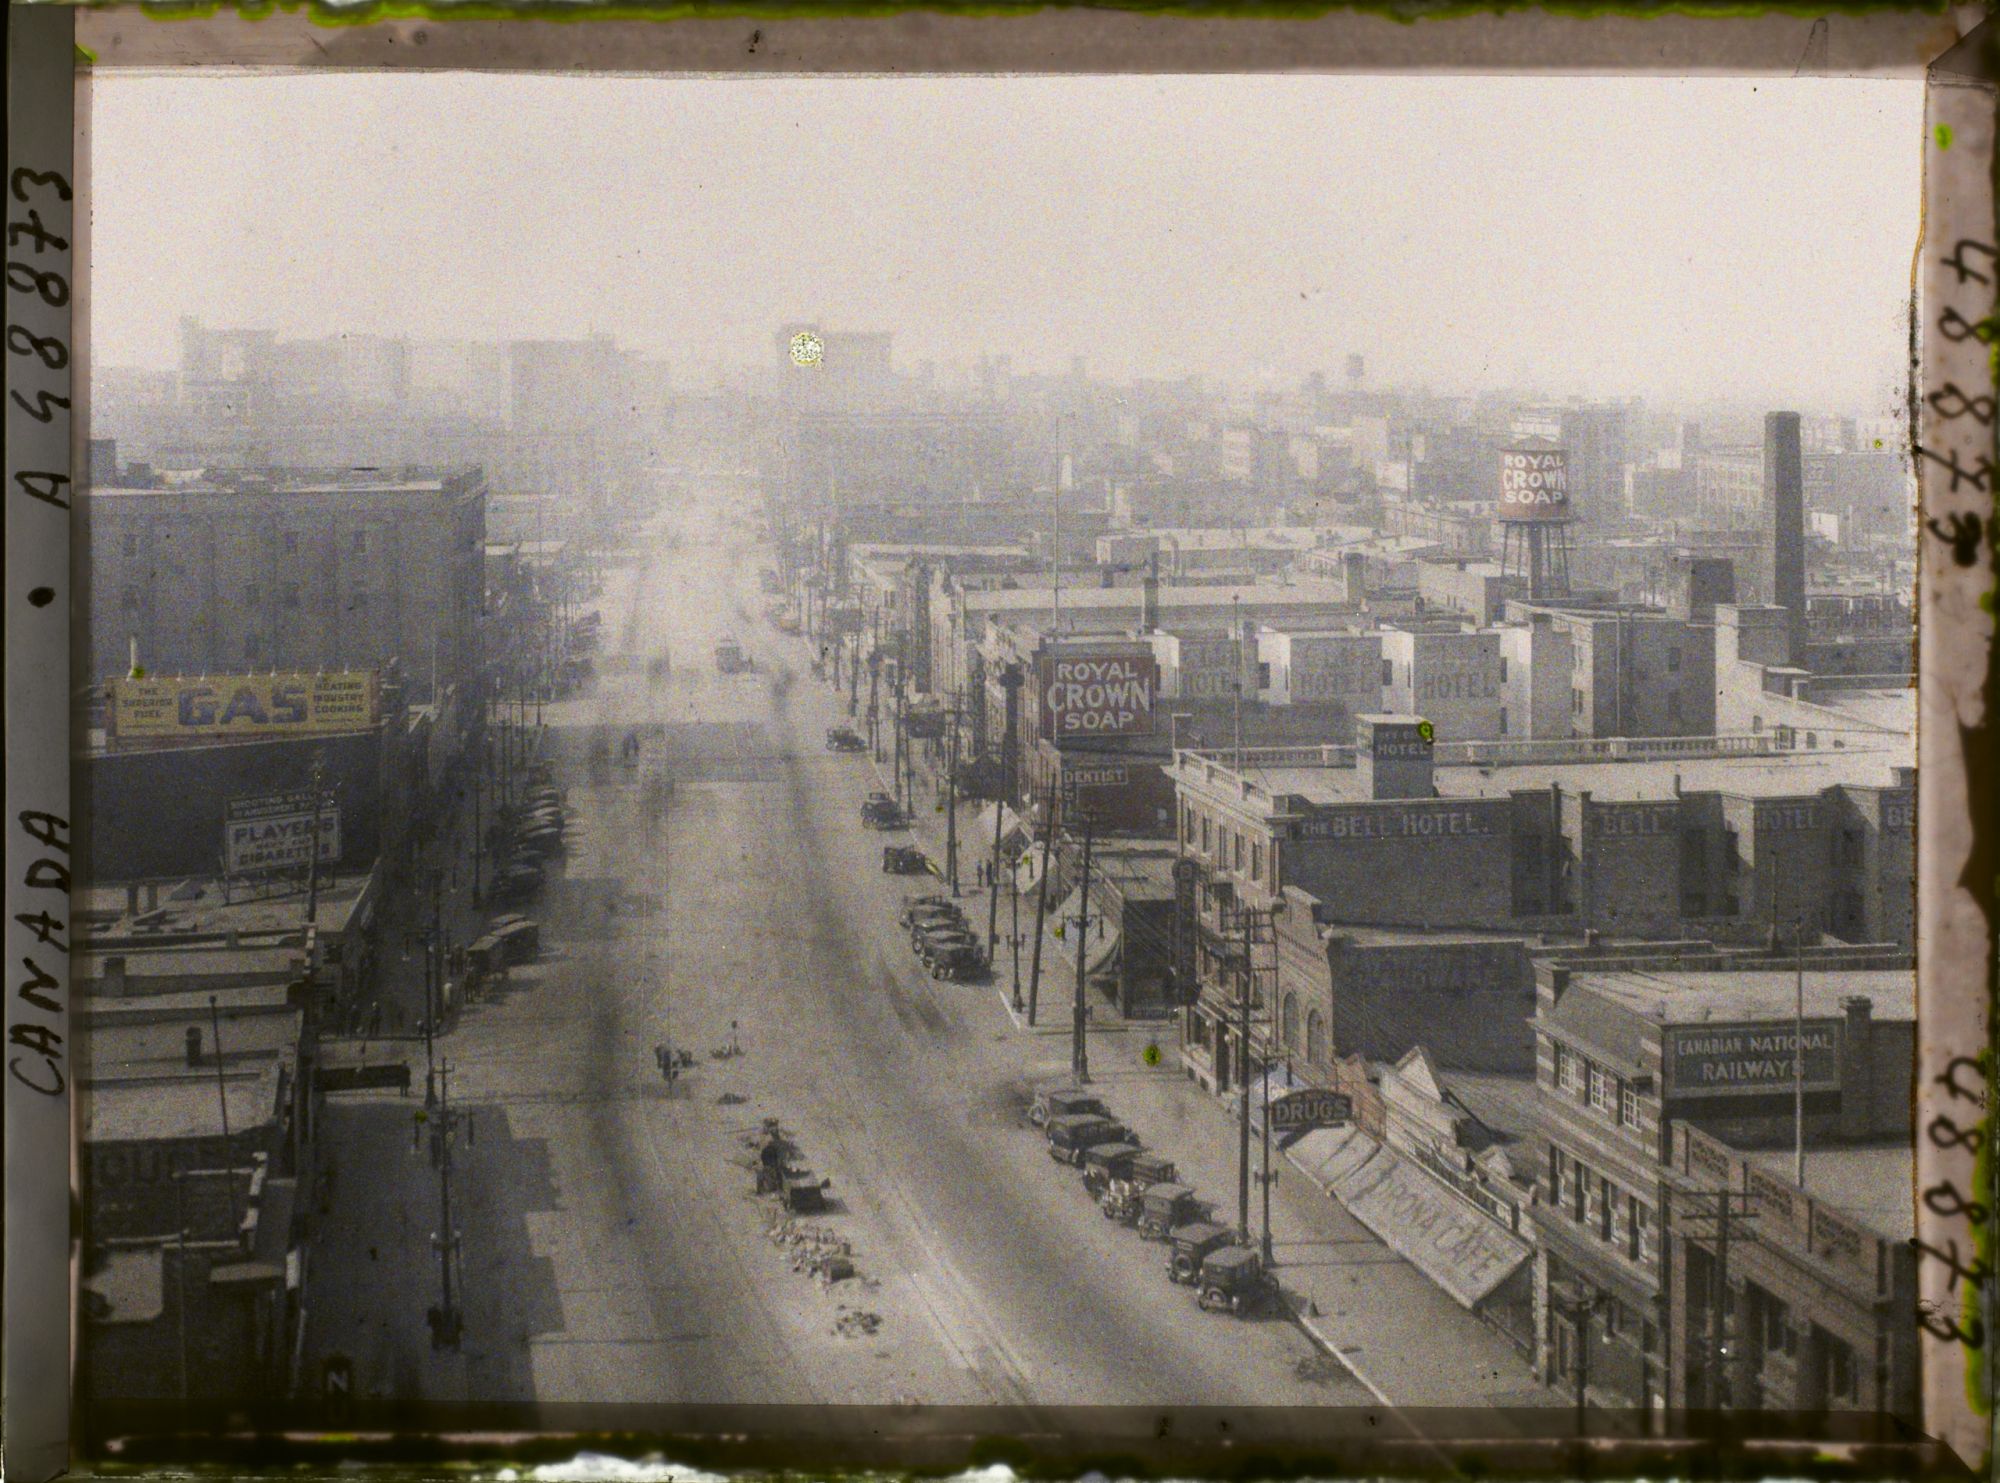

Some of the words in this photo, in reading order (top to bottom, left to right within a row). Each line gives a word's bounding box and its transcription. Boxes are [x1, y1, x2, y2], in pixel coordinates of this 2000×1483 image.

[7, 167, 72, 423] 48873
[1911, 238, 2000, 568] 48873
[1504, 454, 1564, 469] ROYAL
[1503, 466, 1567, 490] CROWN
[15, 471, 71, 509] A
[1504, 489, 1564, 504] SOAP
[1057, 662, 1138, 681] ROYAL
[138, 687, 159, 696] THE
[314, 681, 363, 691] HEATING
[1047, 678, 1150, 712] CROWN
[1422, 671, 1497, 700] HOTEL
[177, 686, 308, 726] GAS
[314, 704, 364, 714] COOKING
[1064, 711, 1135, 730] SOAP
[1377, 742, 1429, 756] HOTEL
[1063, 769, 1124, 784] DENTIST
[1301, 821, 1329, 835] THE
[1333, 814, 1391, 838] BELL
[1603, 810, 1663, 835] BELL
[9, 811, 70, 1095] CANADA
[1677, 1036, 1742, 1056] CANADIAN
[1749, 1033, 1833, 1051] NATIONAL
[1702, 1059, 1805, 1081] RAILWAYS
[1276, 1099, 1347, 1122] DRUGS
[1910, 1057, 1995, 1349] 48873
[1433, 1220, 1504, 1282] CAFE
